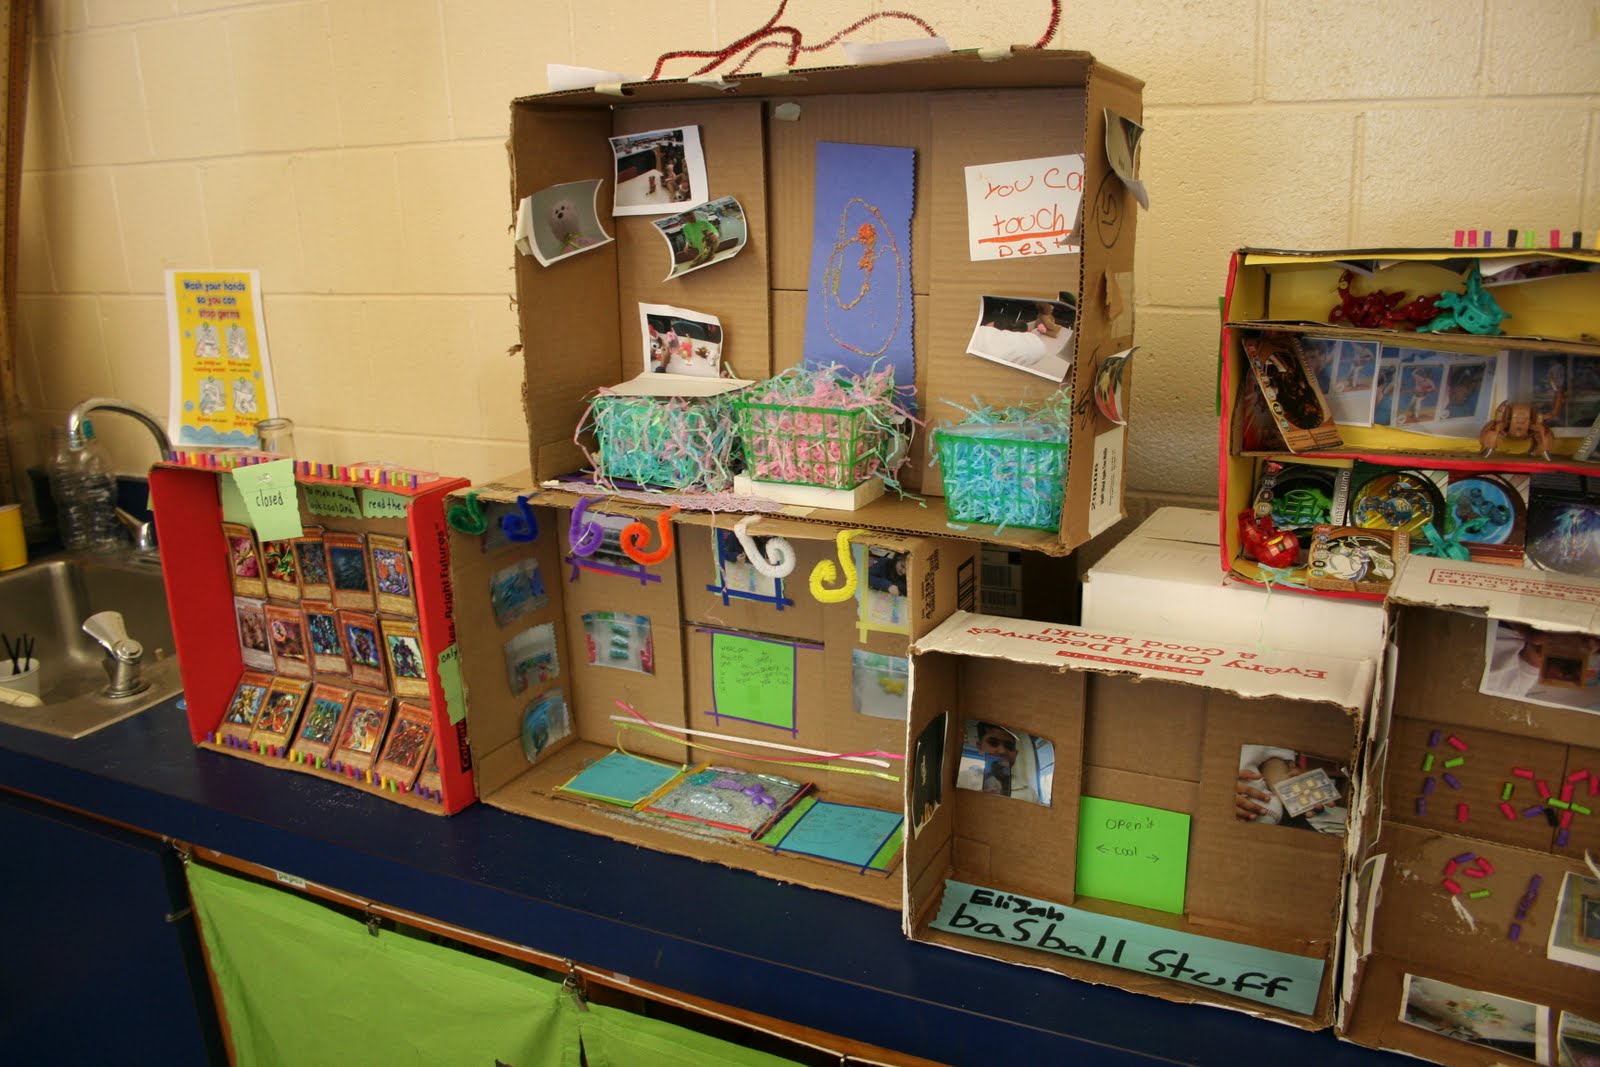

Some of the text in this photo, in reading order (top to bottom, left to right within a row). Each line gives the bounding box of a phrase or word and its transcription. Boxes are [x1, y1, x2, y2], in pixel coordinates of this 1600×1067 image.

[1043, 168, 1084, 193] Ca
[183, 280, 246, 292] Wash your hands
[196, 296, 206, 304] so
[207, 297, 221, 306] you
[199, 309, 240, 320] stop germs
[1340, 470, 1350, 492] WIND
[255, 489, 284, 508] closed
[368, 497, 405, 510] read the
[1437, 578, 1497, 589] CLUBS
[1508, 586, 1566, 598] BOOK
[1040, 627, 1260, 660] a Good Book!
[440, 648, 458, 665] only
[965, 625, 1328, 680] Every Child Deserves
[1060, 653, 1181, 672] SCHOLASTIC
[458, 719, 470, 768] Colgat
[1146, 817, 1155, 829] it
[1114, 846, 1137, 857] cool
